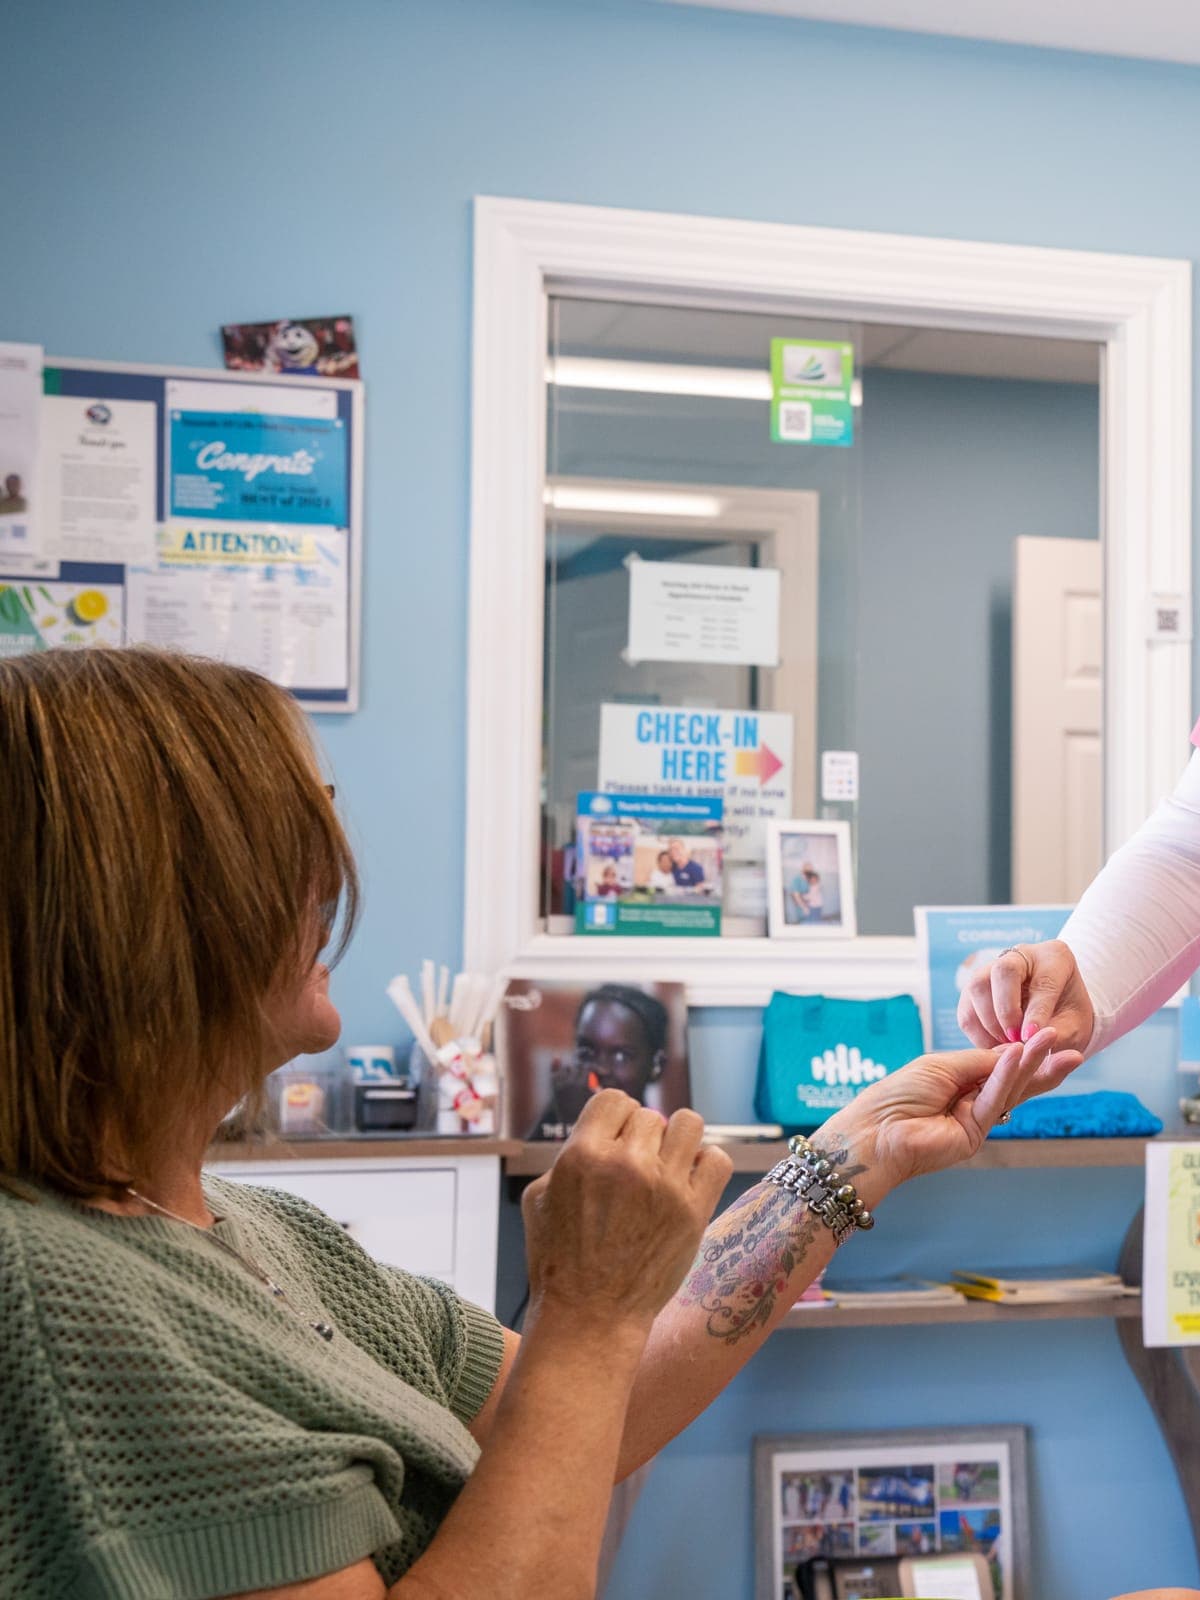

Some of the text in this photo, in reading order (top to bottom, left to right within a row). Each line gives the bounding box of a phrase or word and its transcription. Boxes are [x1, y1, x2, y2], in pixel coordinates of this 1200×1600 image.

[196, 440, 317, 482] Congrats
[636, 711, 759, 748] CHECK-IN
[661, 749, 727, 782] HERE
[605, 781, 649, 793] Please
[654, 783, 681, 795] take
